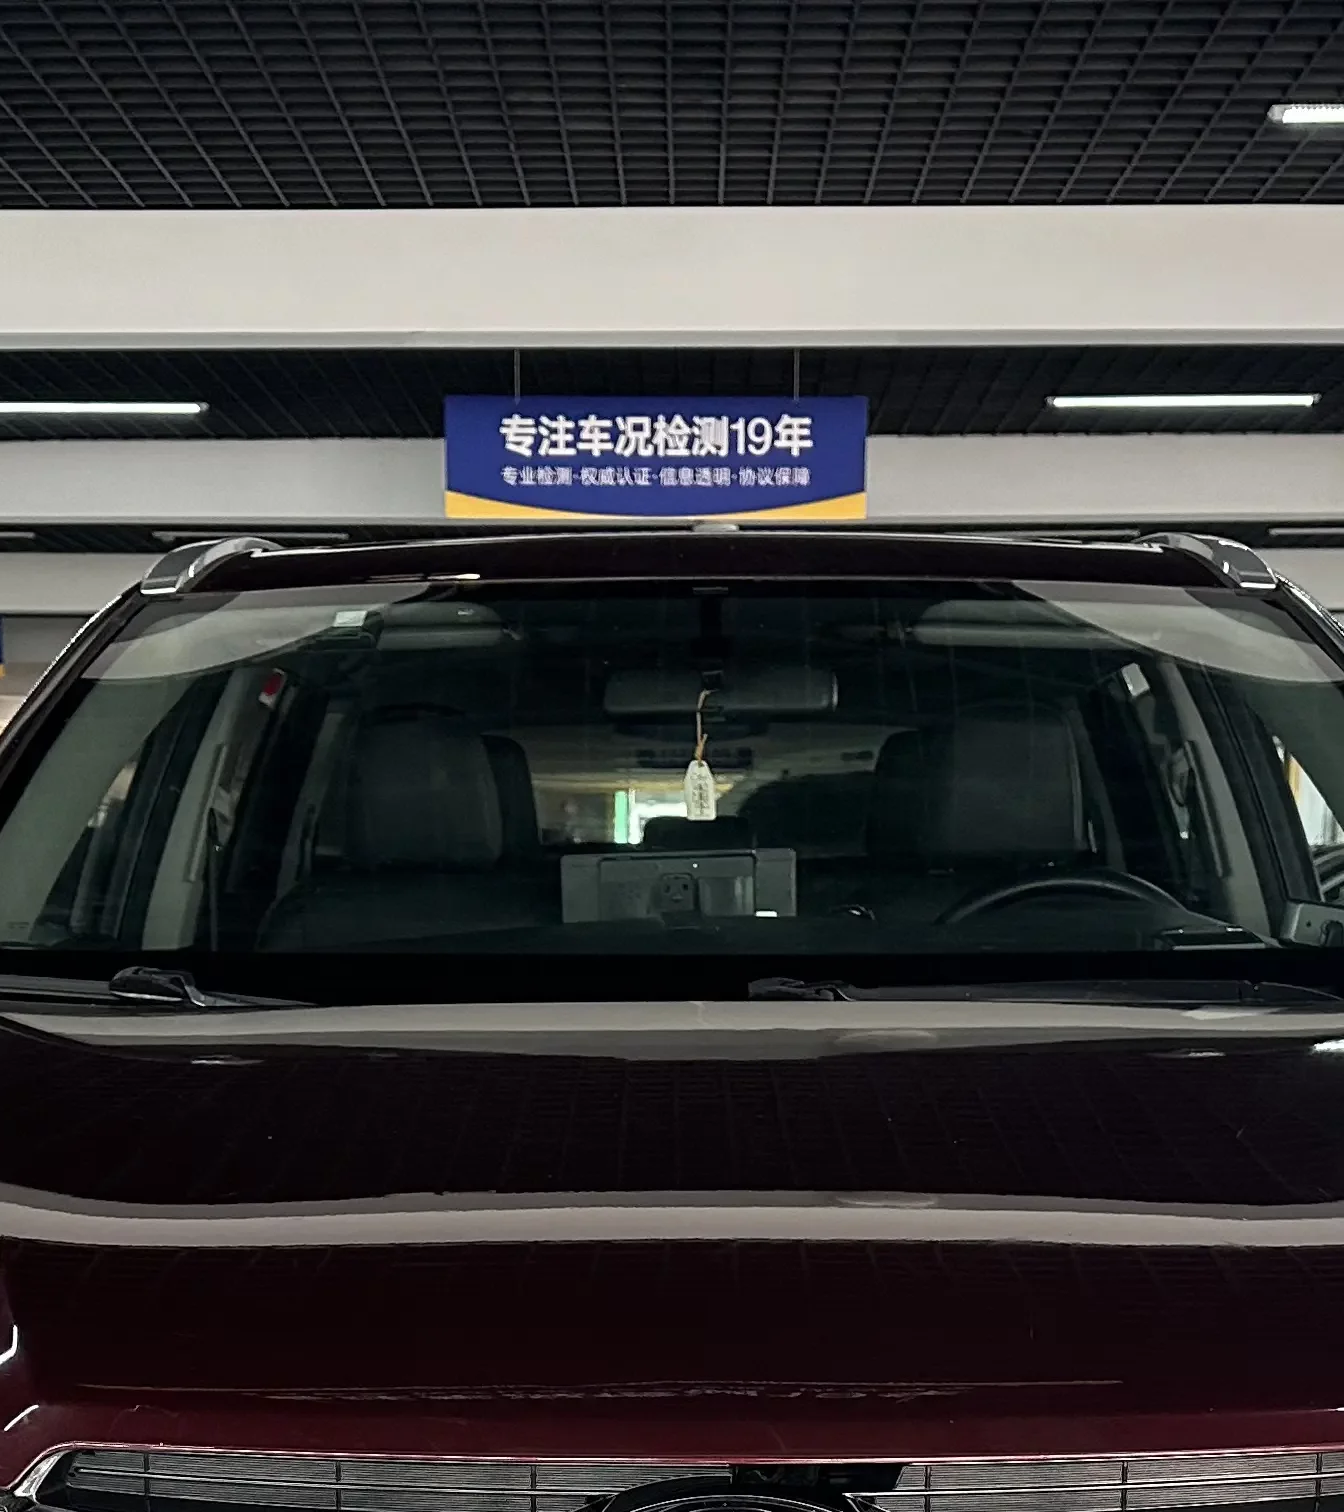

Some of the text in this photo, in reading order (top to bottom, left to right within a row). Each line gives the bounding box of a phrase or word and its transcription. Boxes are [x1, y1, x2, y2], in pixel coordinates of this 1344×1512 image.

[499, 414, 813, 457] 专注车况检测19年
